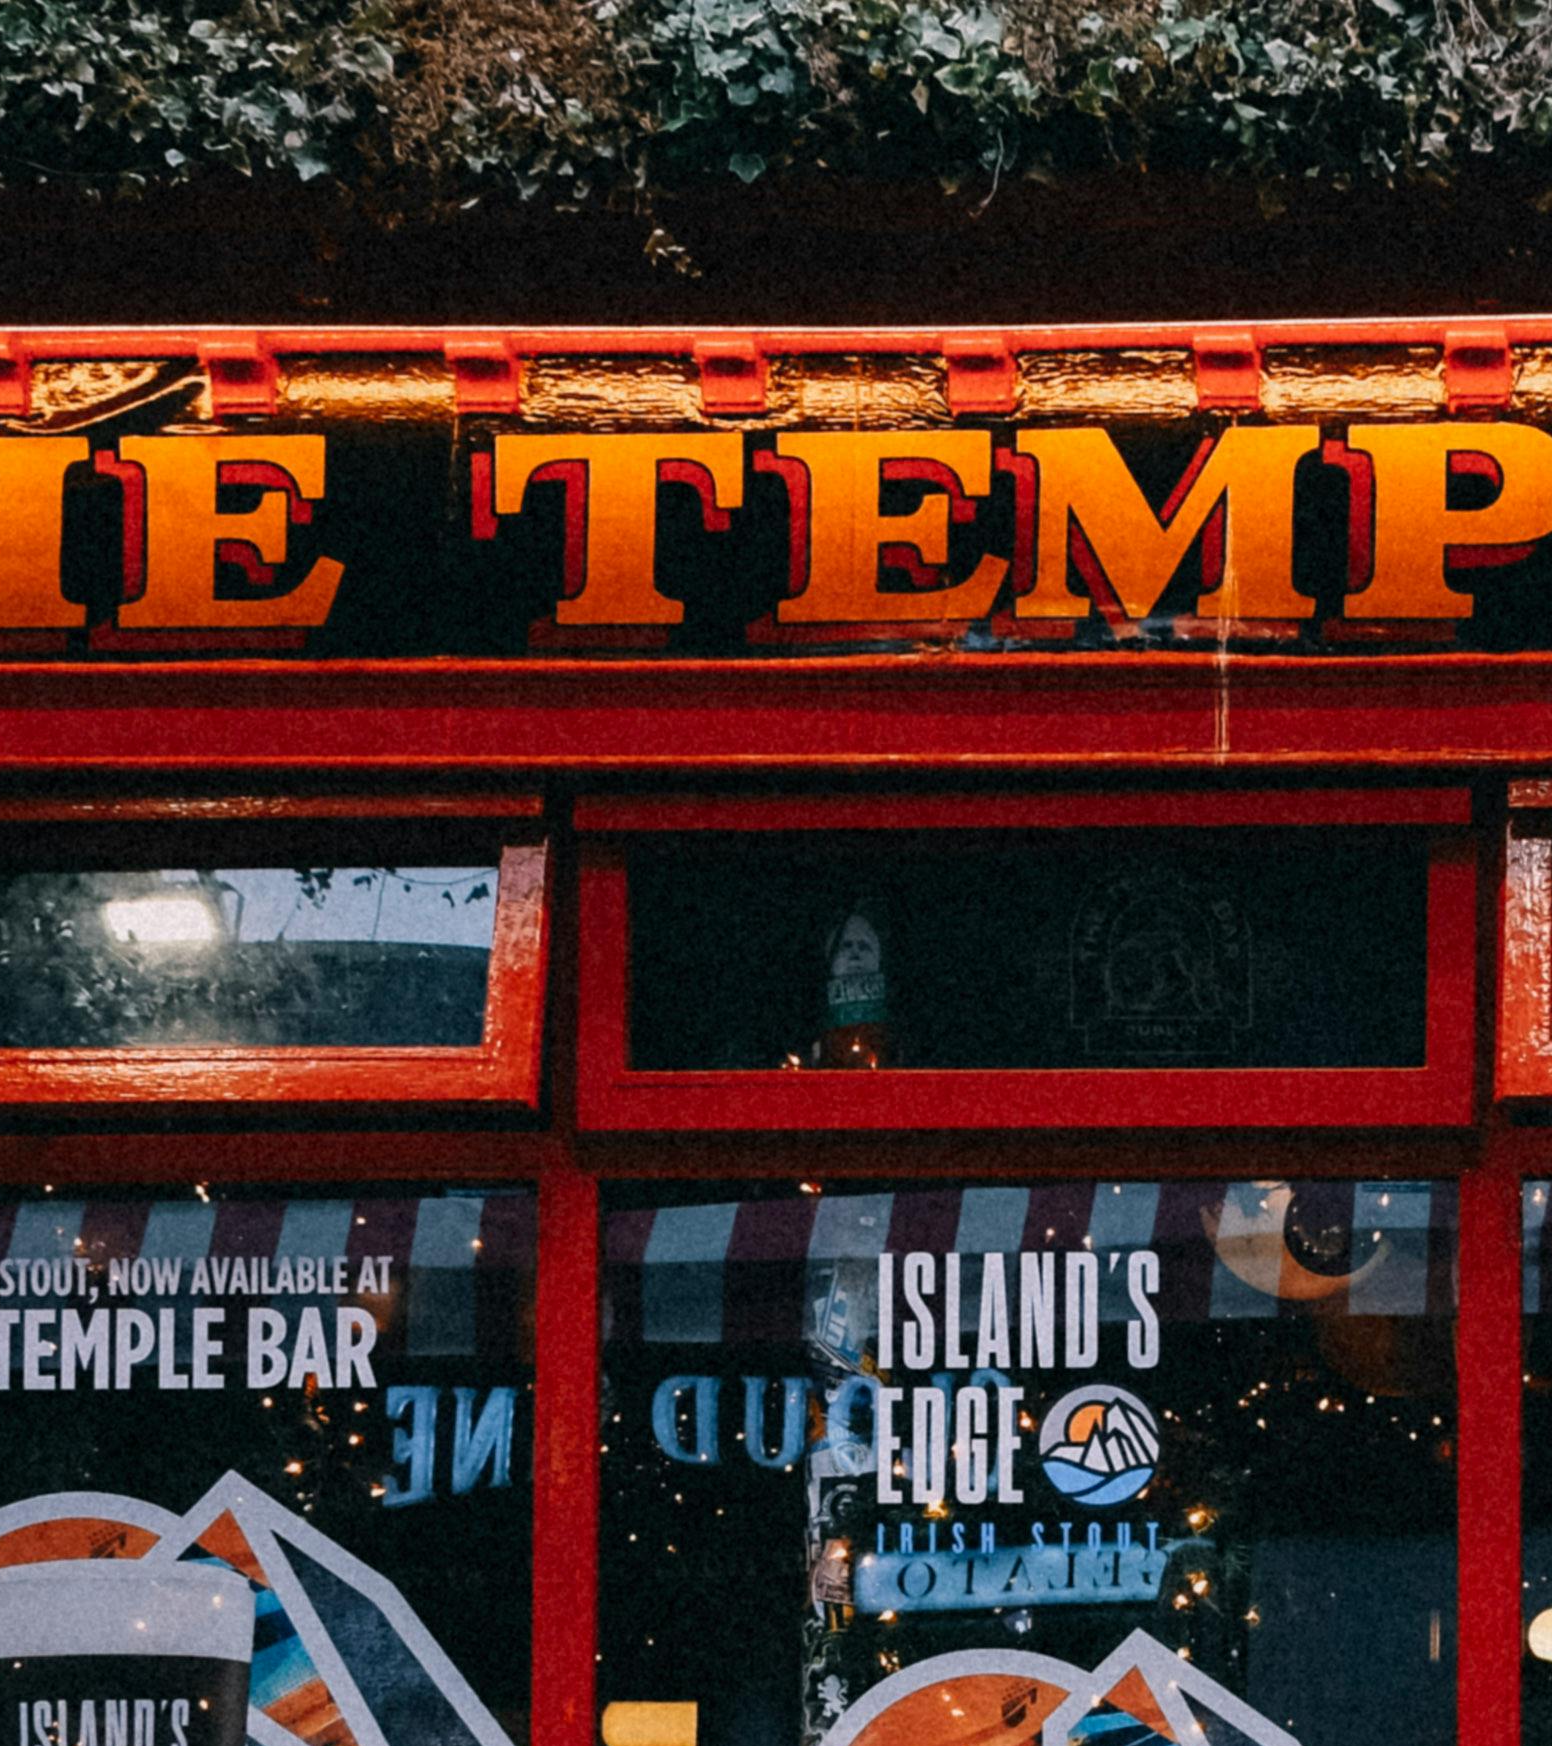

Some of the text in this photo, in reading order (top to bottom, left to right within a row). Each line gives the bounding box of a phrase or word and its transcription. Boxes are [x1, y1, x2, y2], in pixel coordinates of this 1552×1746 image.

[109, 1257, 182, 1297] NOW
[190, 1255, 350, 1295] AVAILABLE
[357, 1255, 393, 1295] AT
[878, 1250, 1160, 1369] ISLAND'S
[249, 1306, 378, 1389] BAR
[877, 1388, 1025, 1505] EDGE
[877, 1522, 1160, 1554] IRISH STOUT
